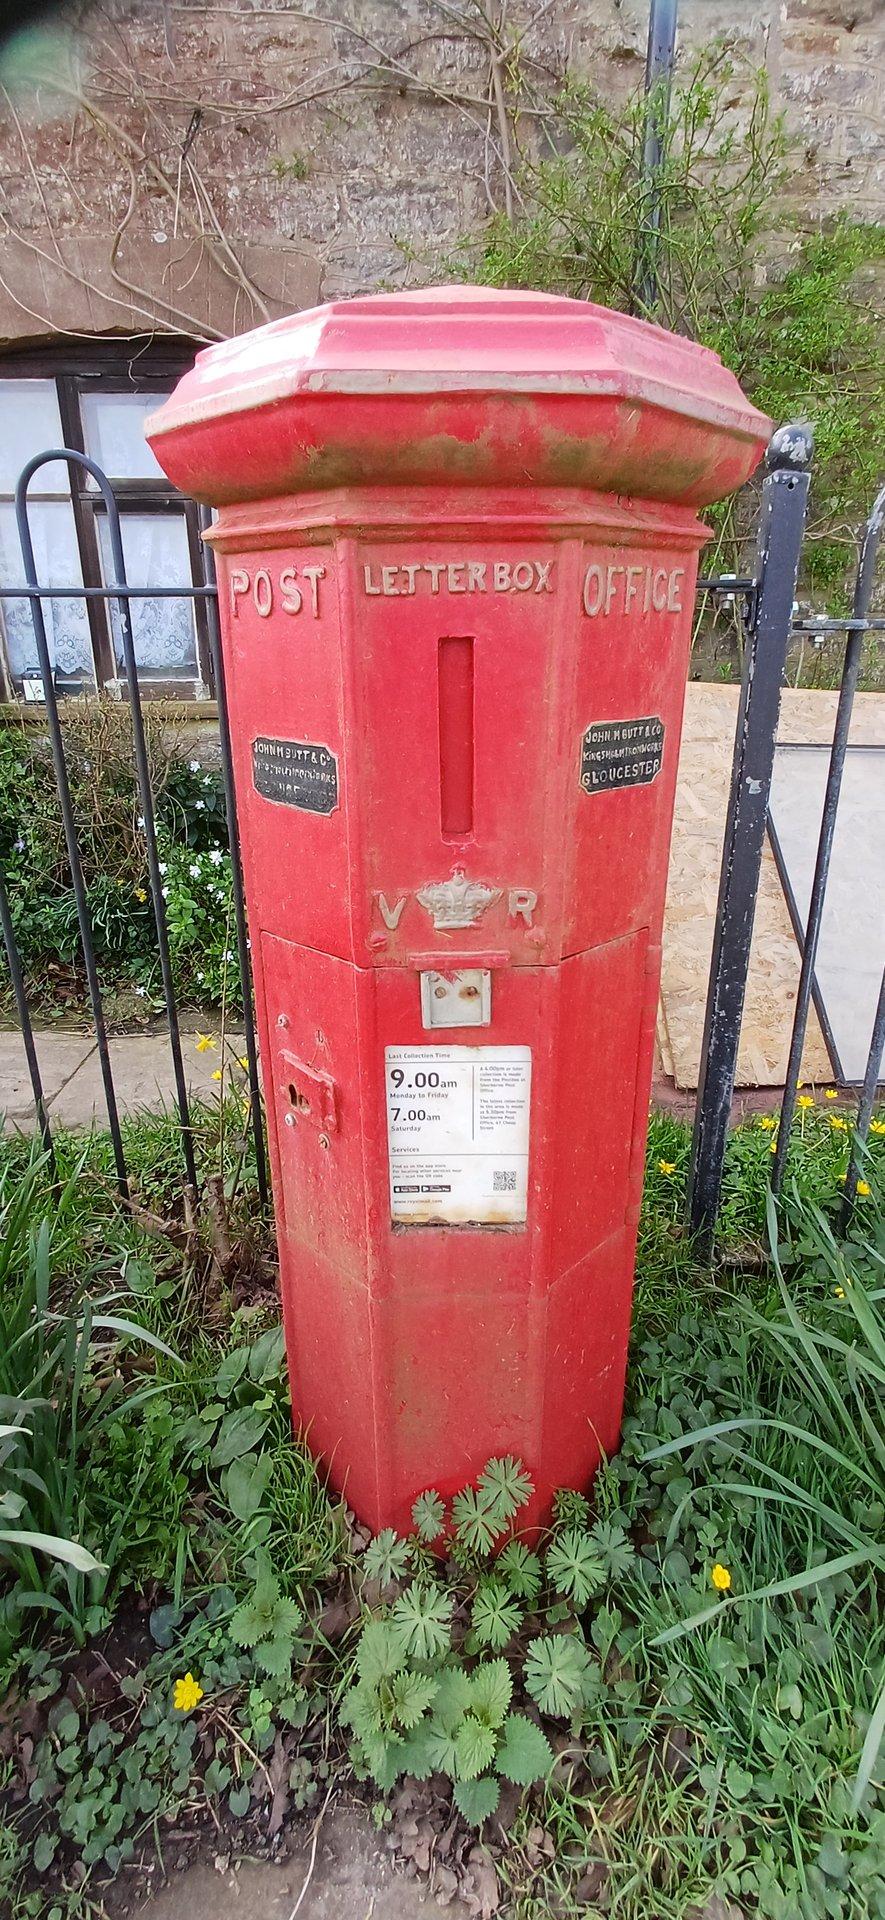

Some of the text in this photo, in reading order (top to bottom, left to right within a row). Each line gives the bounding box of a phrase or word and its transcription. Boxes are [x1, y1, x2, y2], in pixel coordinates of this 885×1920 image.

[229, 567, 327, 619] POST
[582, 564, 686, 617] OFFICE
[254, 741, 276, 757] JOHN
[311, 751, 318, 764] &
[581, 758, 660, 786] GLOUCESTER
[375, 890, 407, 930] V
[506, 887, 539, 928] R
[390, 1068, 458, 1089] 9.00am
[390, 1107, 441, 1122] 7.00am
